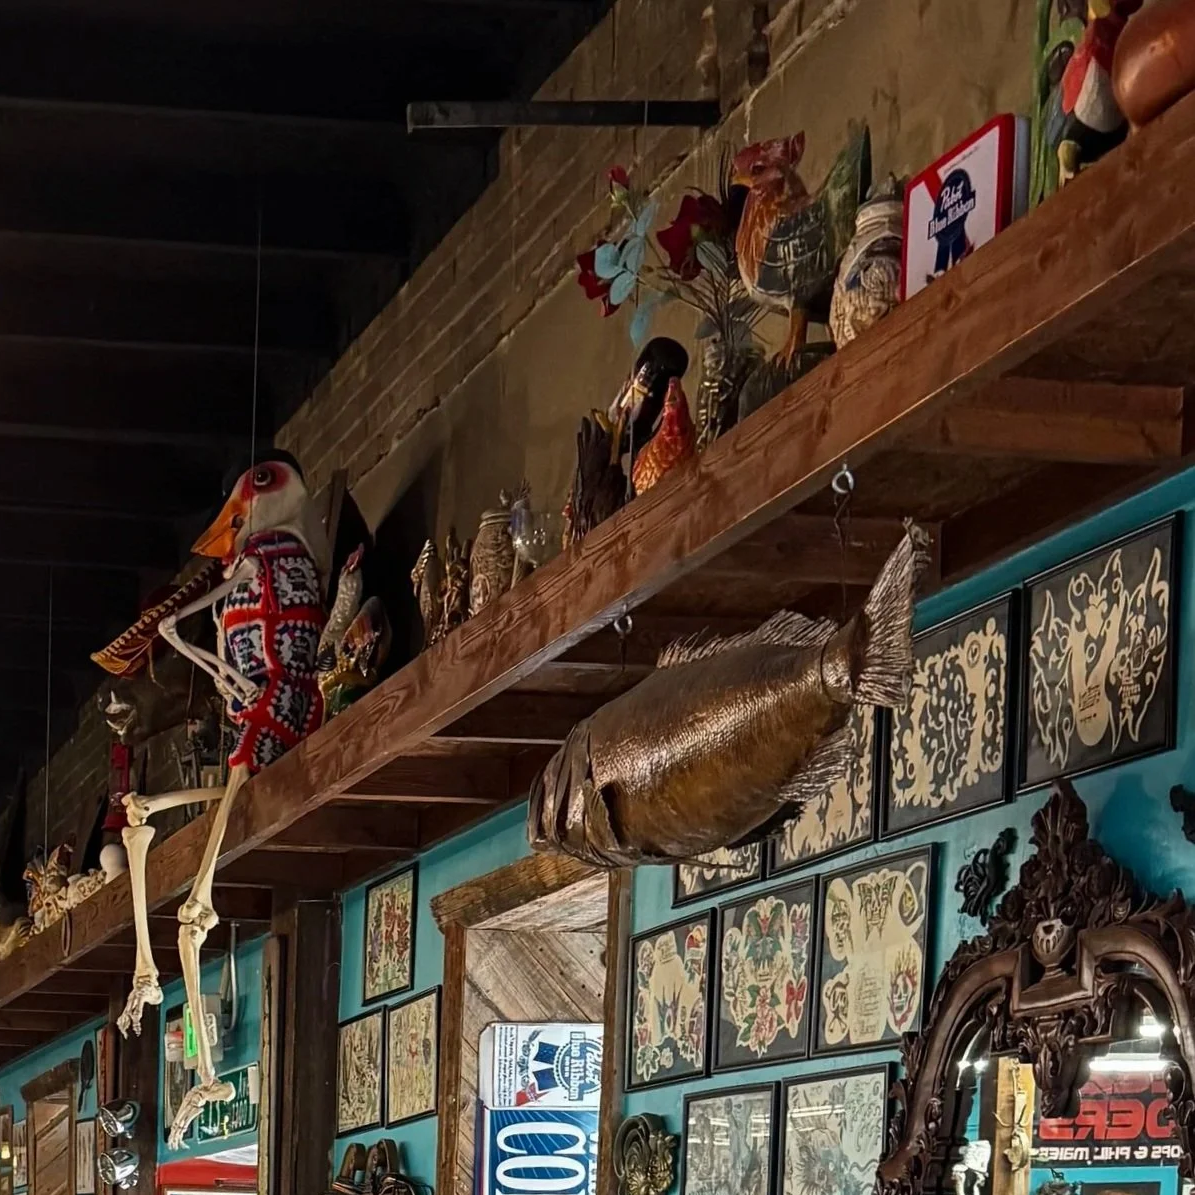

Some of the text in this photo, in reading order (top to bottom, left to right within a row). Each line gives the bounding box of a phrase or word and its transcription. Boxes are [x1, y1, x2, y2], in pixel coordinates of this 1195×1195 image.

[941, 182, 963, 211] Pabst
[947, 198, 975, 221] Ribbon
[570, 1033, 584, 1100] Blue Ribbon
